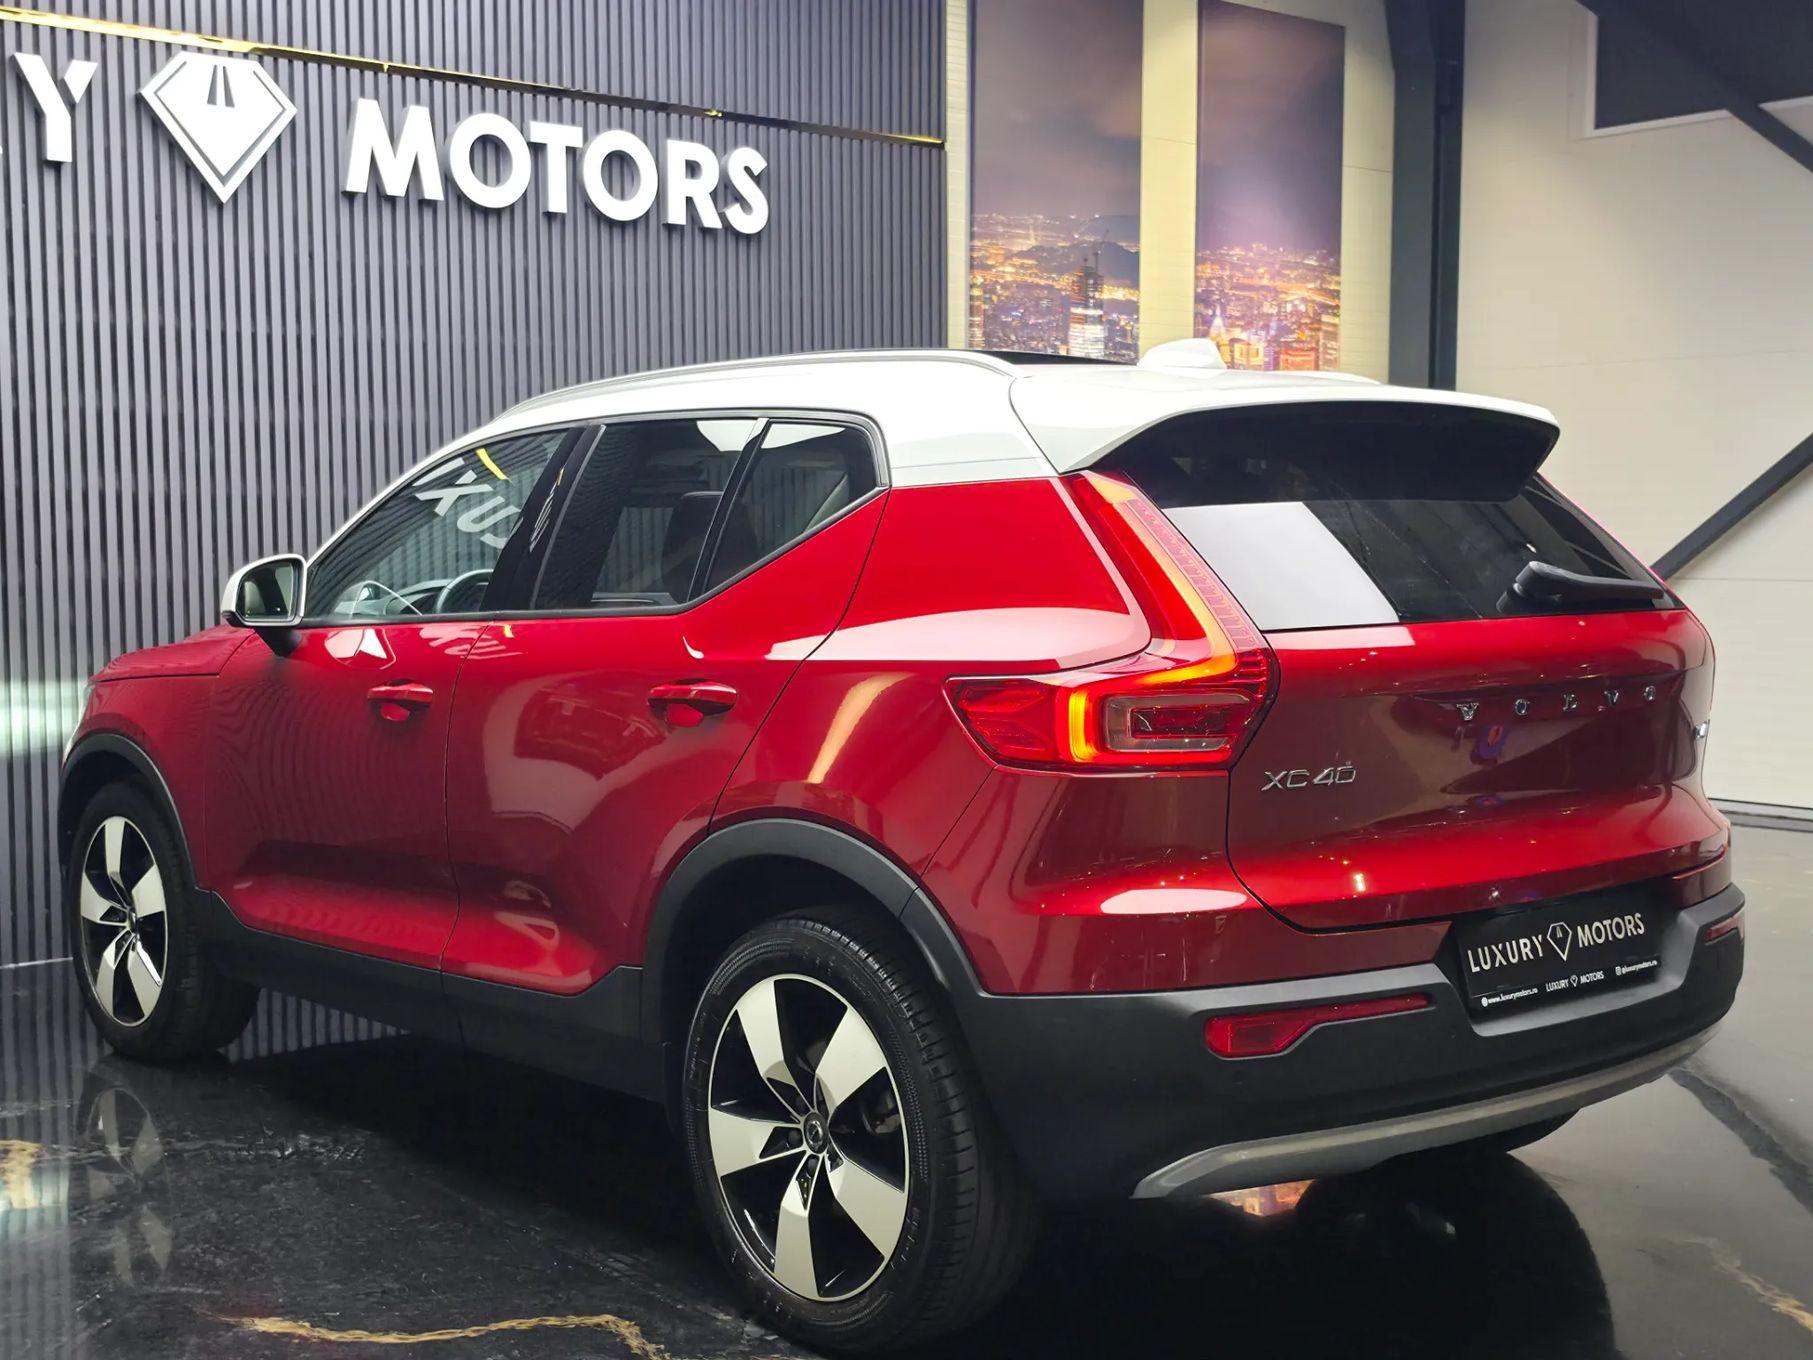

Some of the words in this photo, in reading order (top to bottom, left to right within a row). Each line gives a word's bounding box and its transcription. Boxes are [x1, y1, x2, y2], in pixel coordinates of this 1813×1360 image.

[0, 52, 98, 163] Y
[343, 98, 768, 235] MOTORS
[1456, 685, 1657, 721] VOLVO
[1261, 766, 1357, 792] XC40
[1467, 934, 1543, 973] LUXURY
[1578, 913, 1645, 947] MOTORS
[1546, 979, 1569, 992] LUXURY
[1580, 971, 1604, 983] MOTORS
